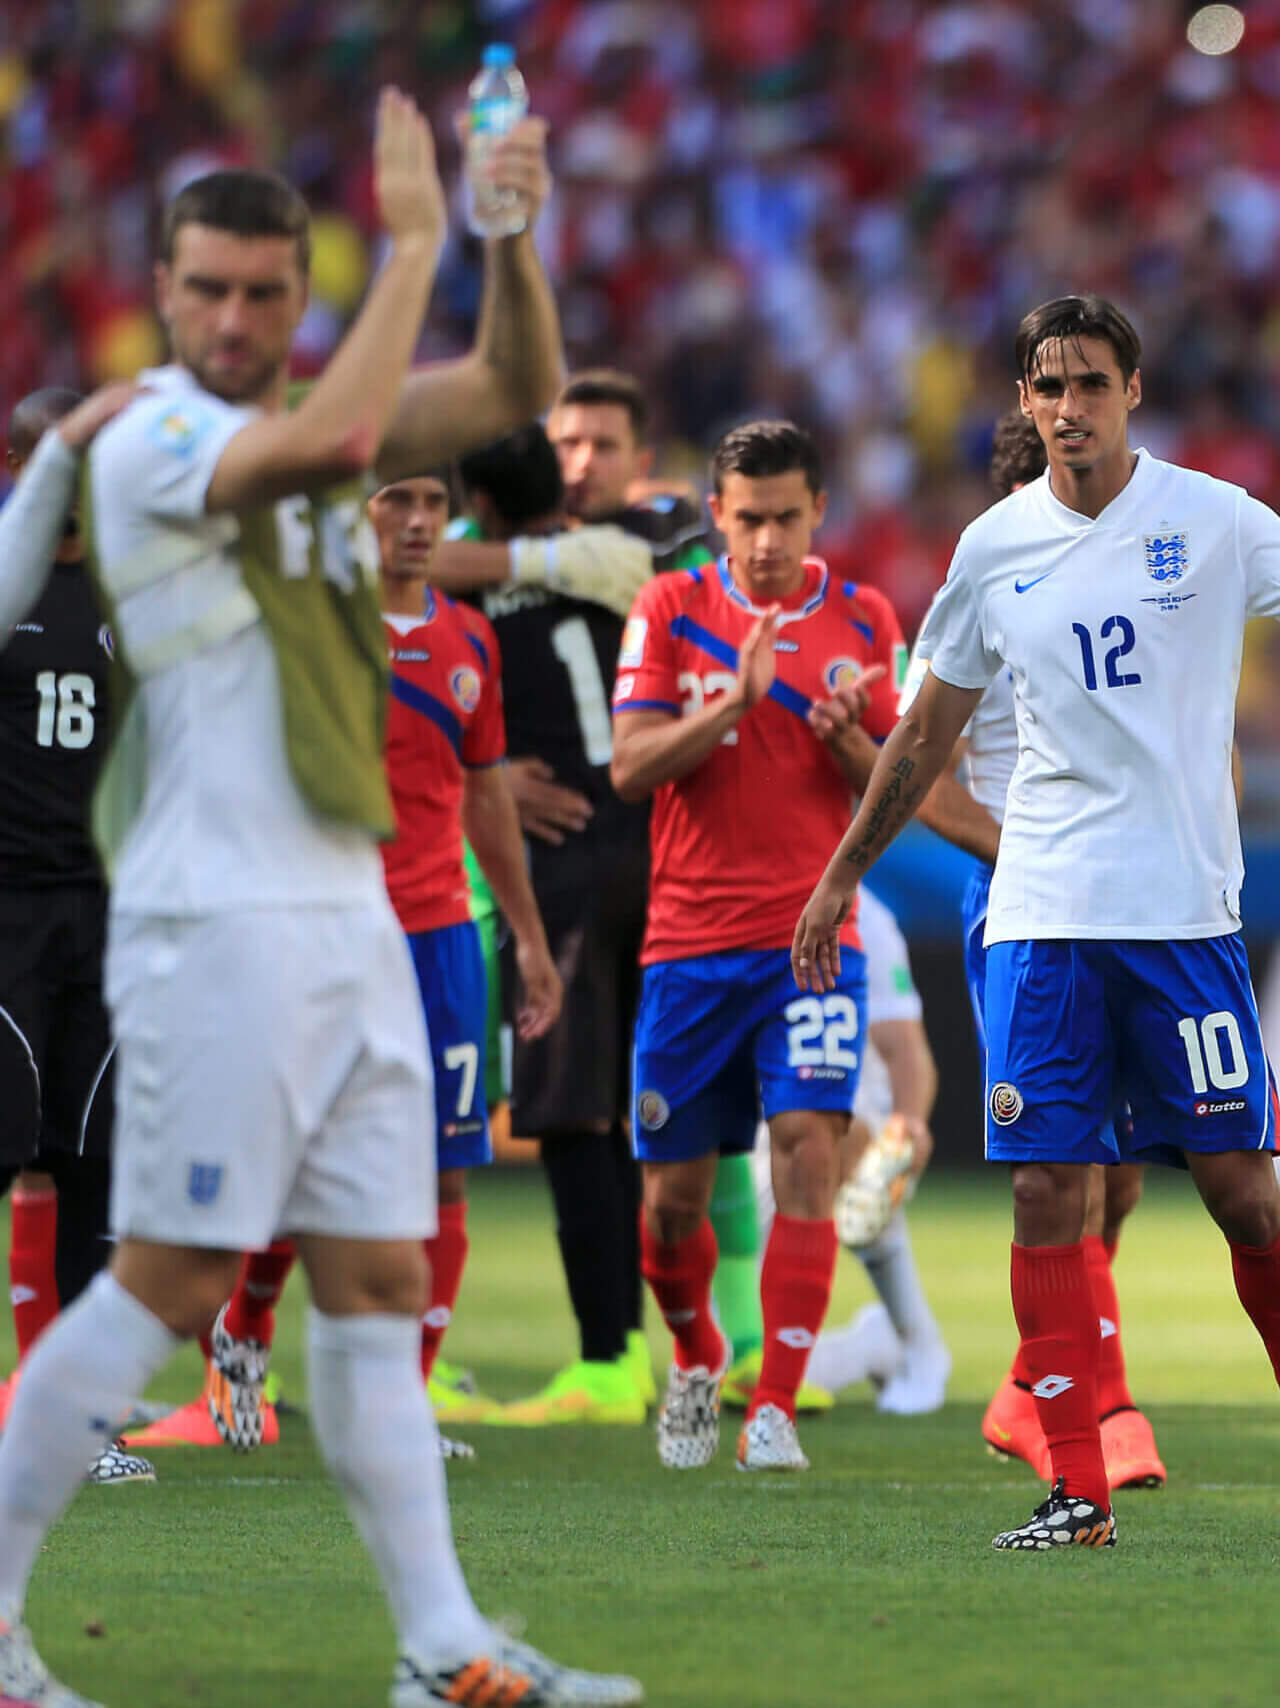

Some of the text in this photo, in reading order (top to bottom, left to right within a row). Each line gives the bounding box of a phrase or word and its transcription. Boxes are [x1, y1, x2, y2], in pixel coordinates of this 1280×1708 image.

[1071, 615, 1142, 690] 12
[36, 671, 95, 748] 16
[552, 616, 613, 766] 1
[784, 995, 858, 1068] 22
[1178, 1010, 1249, 1094] 10
[444, 1043, 478, 1117] 7
[1209, 1101, 1246, 1113] lotto
